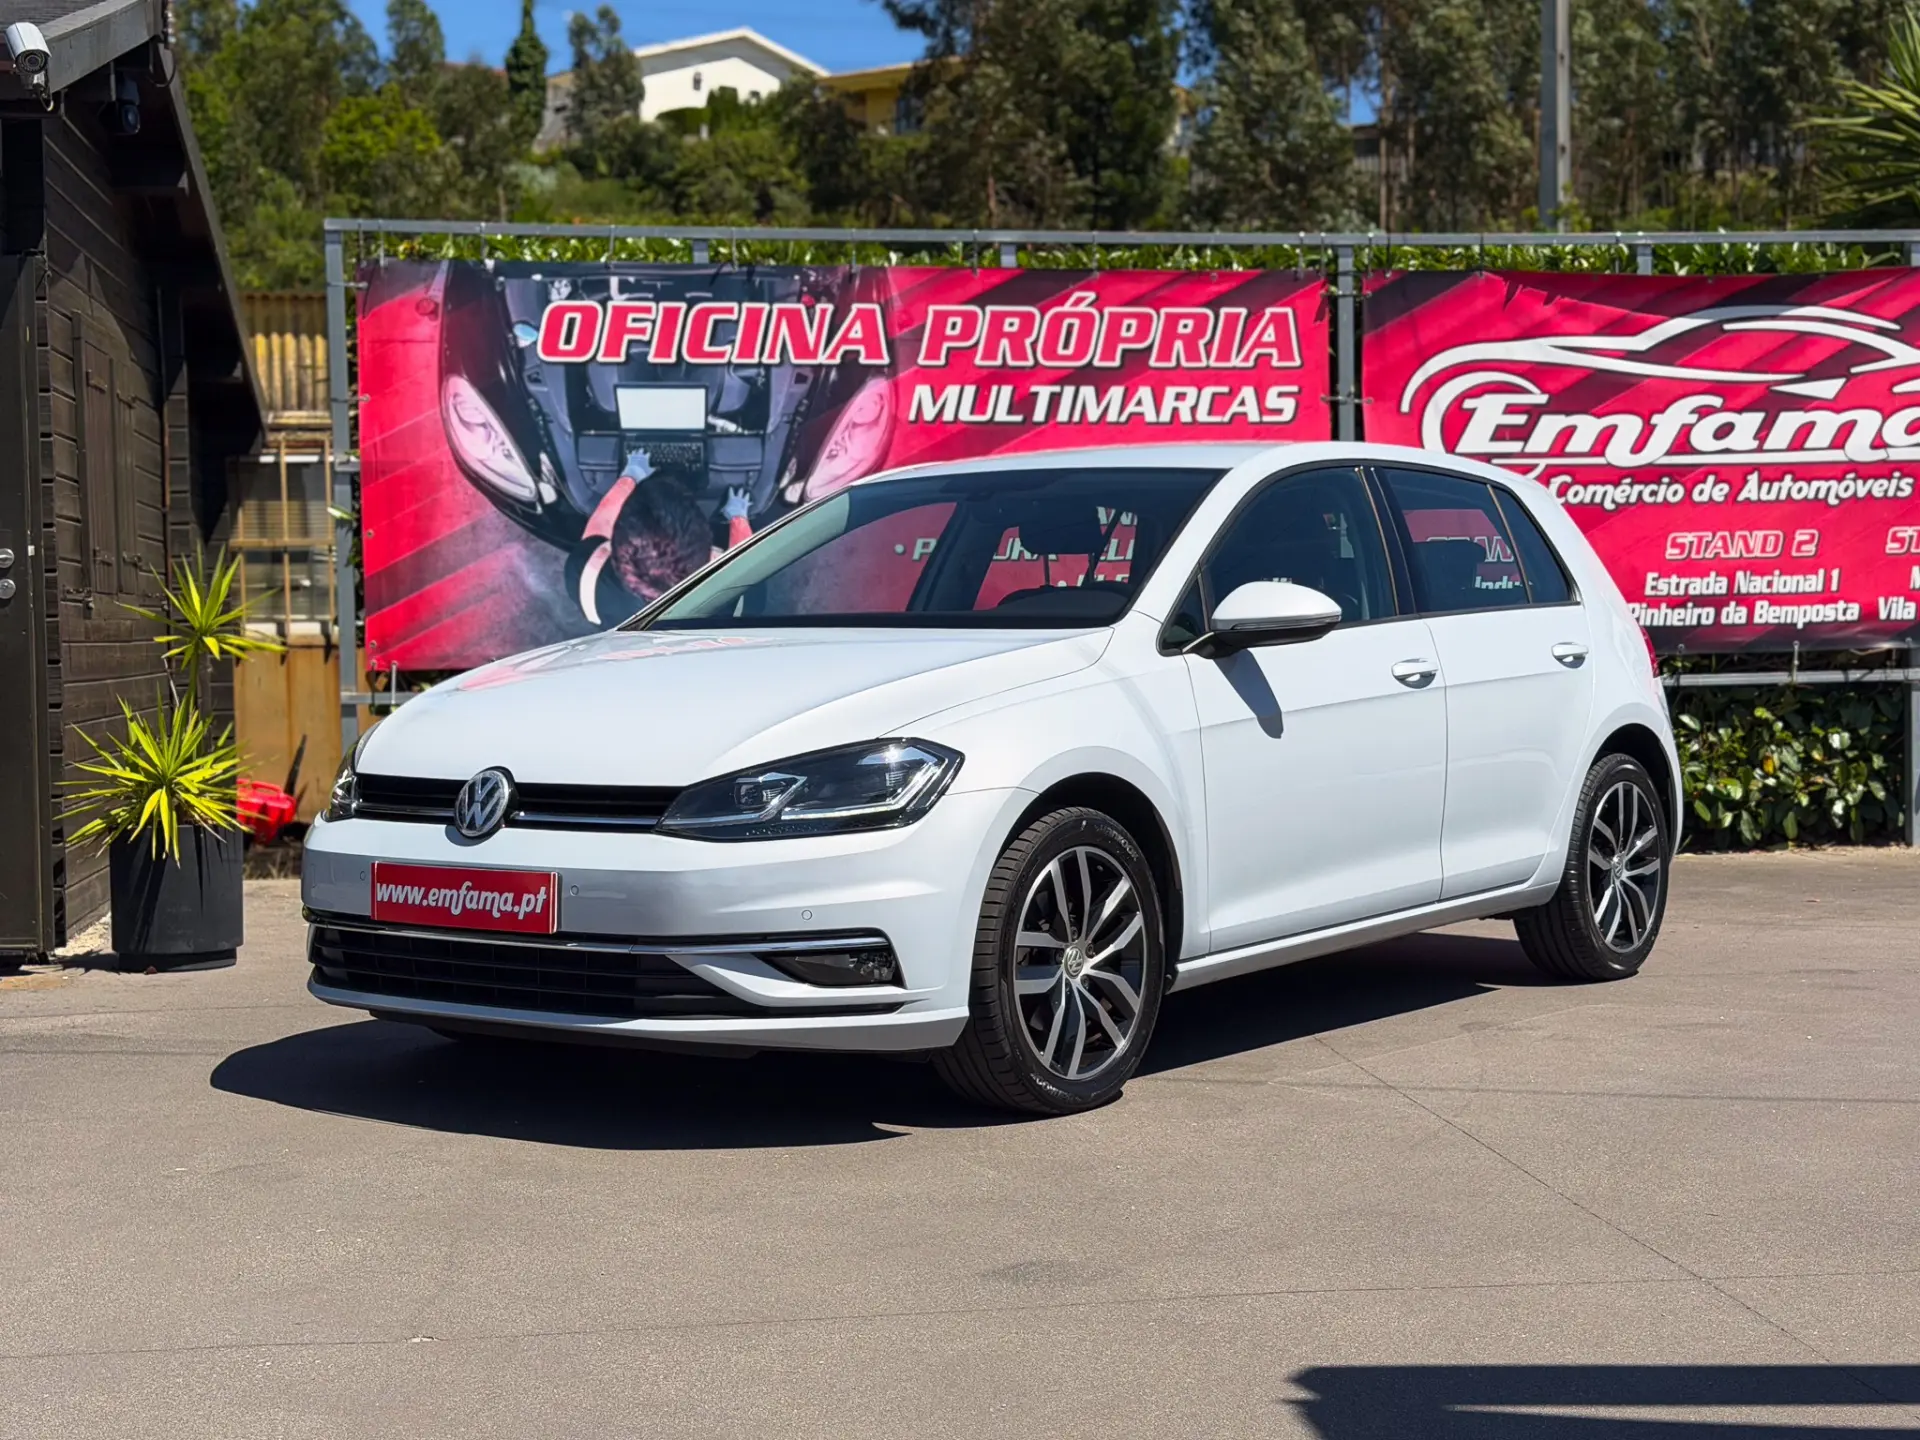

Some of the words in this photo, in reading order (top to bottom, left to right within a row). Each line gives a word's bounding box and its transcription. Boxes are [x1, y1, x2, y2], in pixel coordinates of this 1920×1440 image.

[537, 301, 890, 364] OFICINA
[917, 291, 1301, 367] PRÓPRIA
[908, 384, 1299, 423] MULTIMARCAS
[1549, 474, 1685, 510] Comércio
[1691, 474, 1730, 503] de
[1736, 470, 1914, 506] Automóveis
[1665, 531, 1784, 560] STAND
[1791, 529, 1819, 557] 2
[1644, 571, 1728, 596] Estrada
[1733, 569, 1825, 595] Nacional
[1829, 567, 1841, 593] 1
[1720, 600, 1748, 625] da
[1753, 600, 1860, 630] Bemposta
[1877, 596, 1917, 620] Vila
[376, 881, 547, 920] www.emfama.pt
